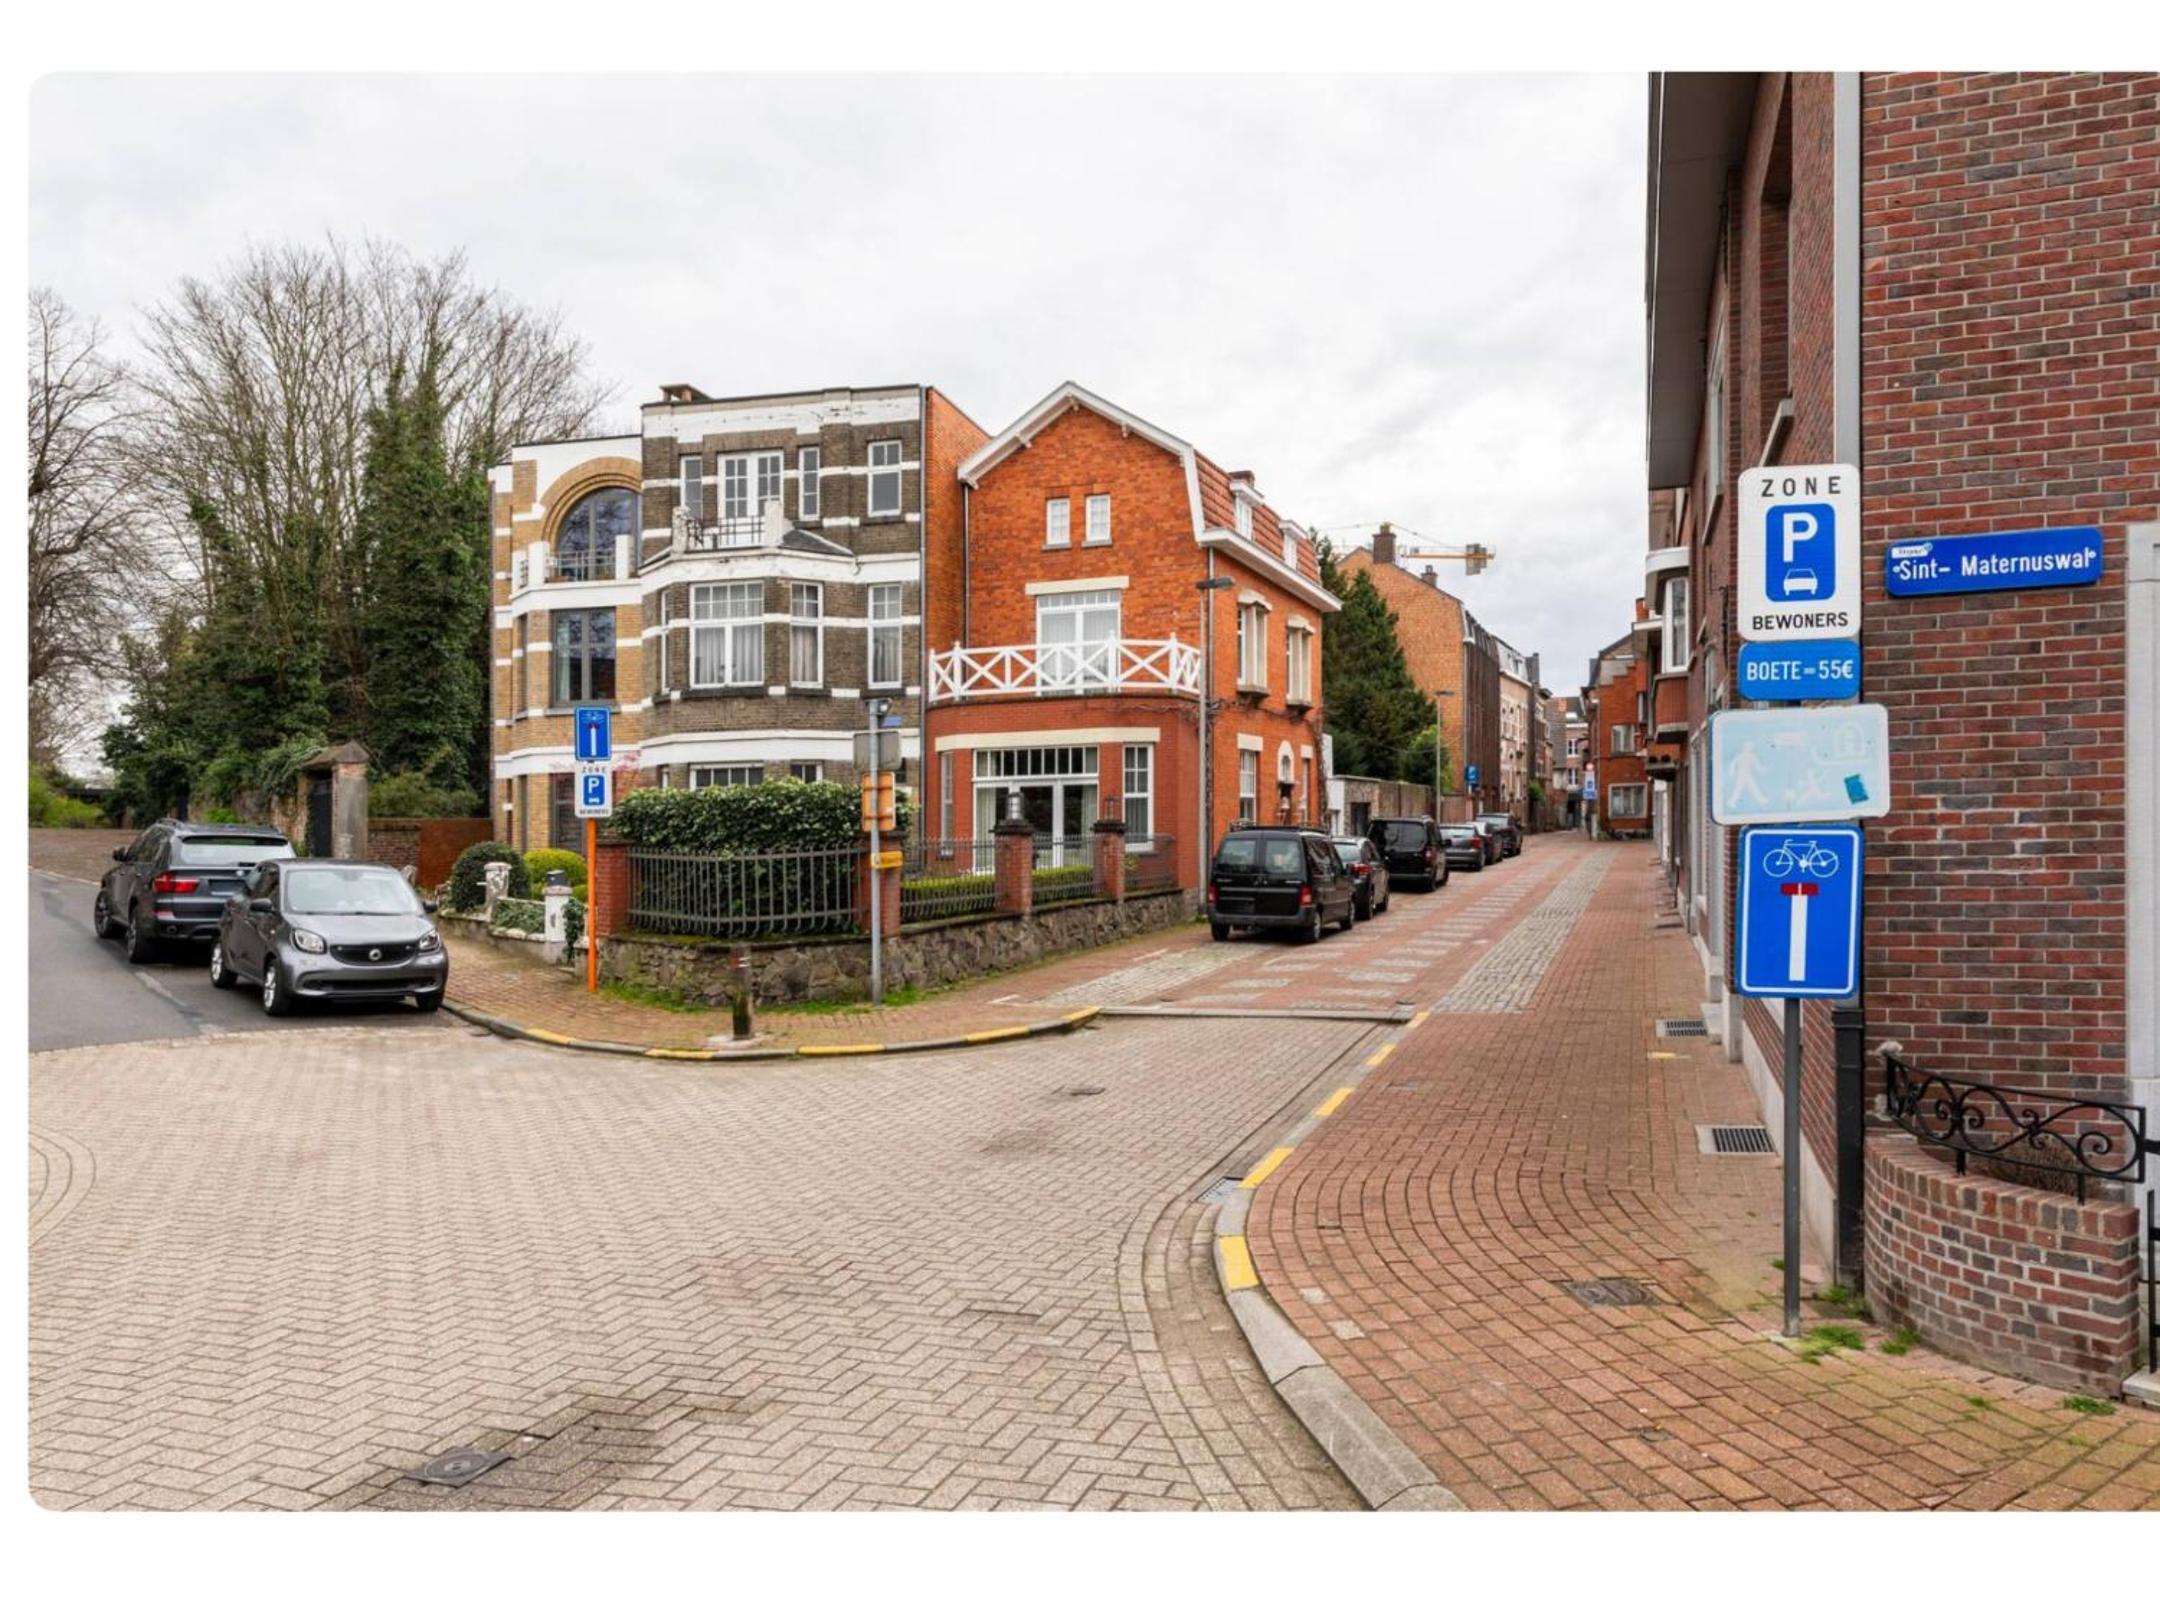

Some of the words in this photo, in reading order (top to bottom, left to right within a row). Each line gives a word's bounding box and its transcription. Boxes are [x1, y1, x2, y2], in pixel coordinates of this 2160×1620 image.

[1761, 476, 1841, 497] ZONE
[1783, 512, 1818, 562] P
[1899, 557, 1952, 580] Sint-
[1961, 546, 2090, 576] Maternuswal
[1752, 612, 1848, 630] BEWONERS
[588, 777, 600, 794] P
